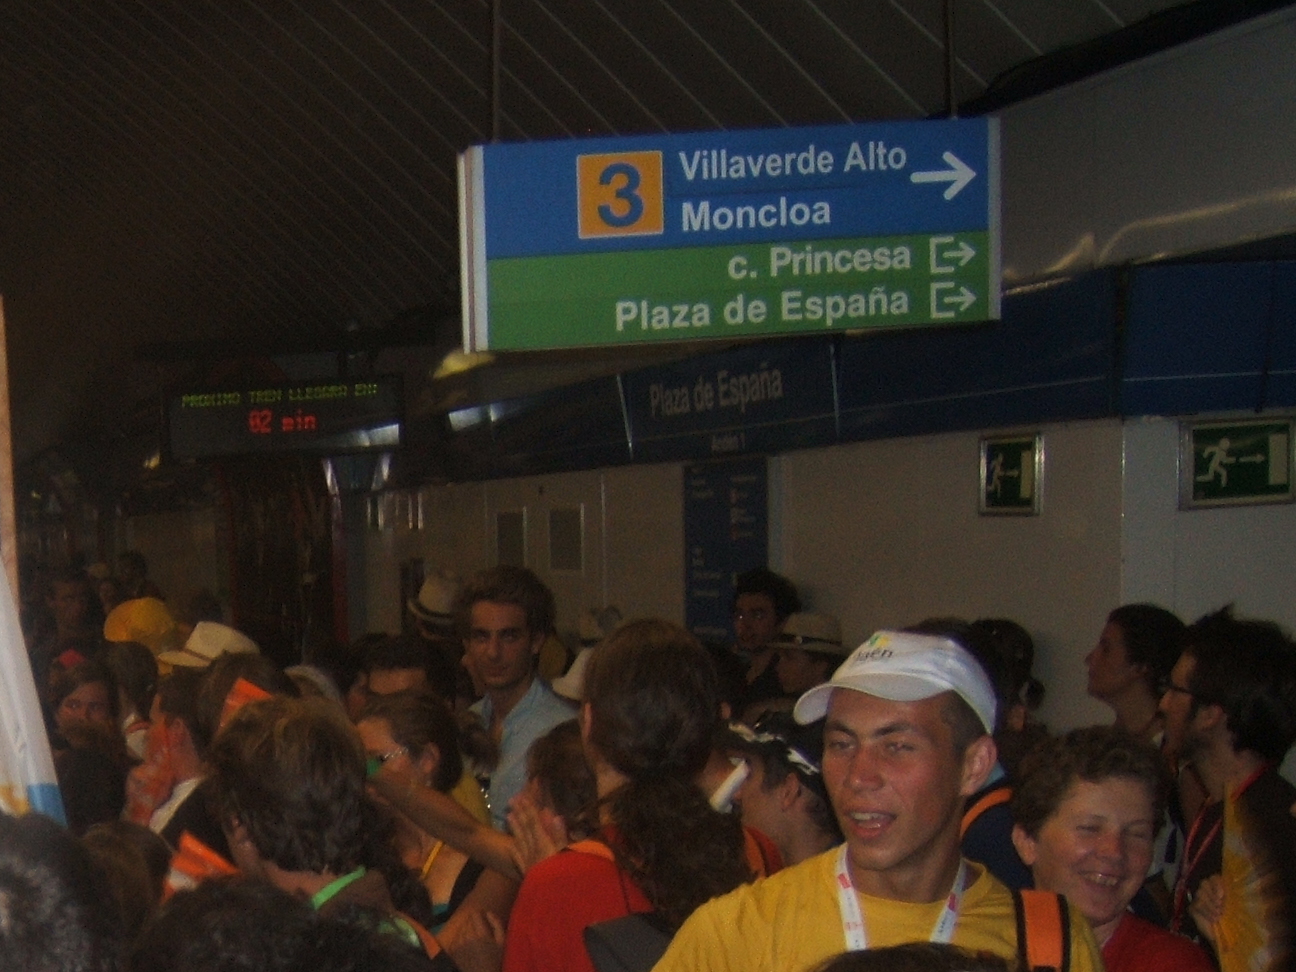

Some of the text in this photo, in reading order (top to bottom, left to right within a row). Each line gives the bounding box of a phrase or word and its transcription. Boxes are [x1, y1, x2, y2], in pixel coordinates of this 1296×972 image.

[678, 142, 908, 182] Villaverde Alto
[596, 162, 645, 228] 3
[681, 196, 832, 233] Moncloa
[727, 243, 912, 280] c. Princesa
[614, 285, 910, 332] Plaza de España
[249, 388, 282, 404] TREN
[649, 361, 784, 417] Plaza de España
[281, 409, 317, 432] min
